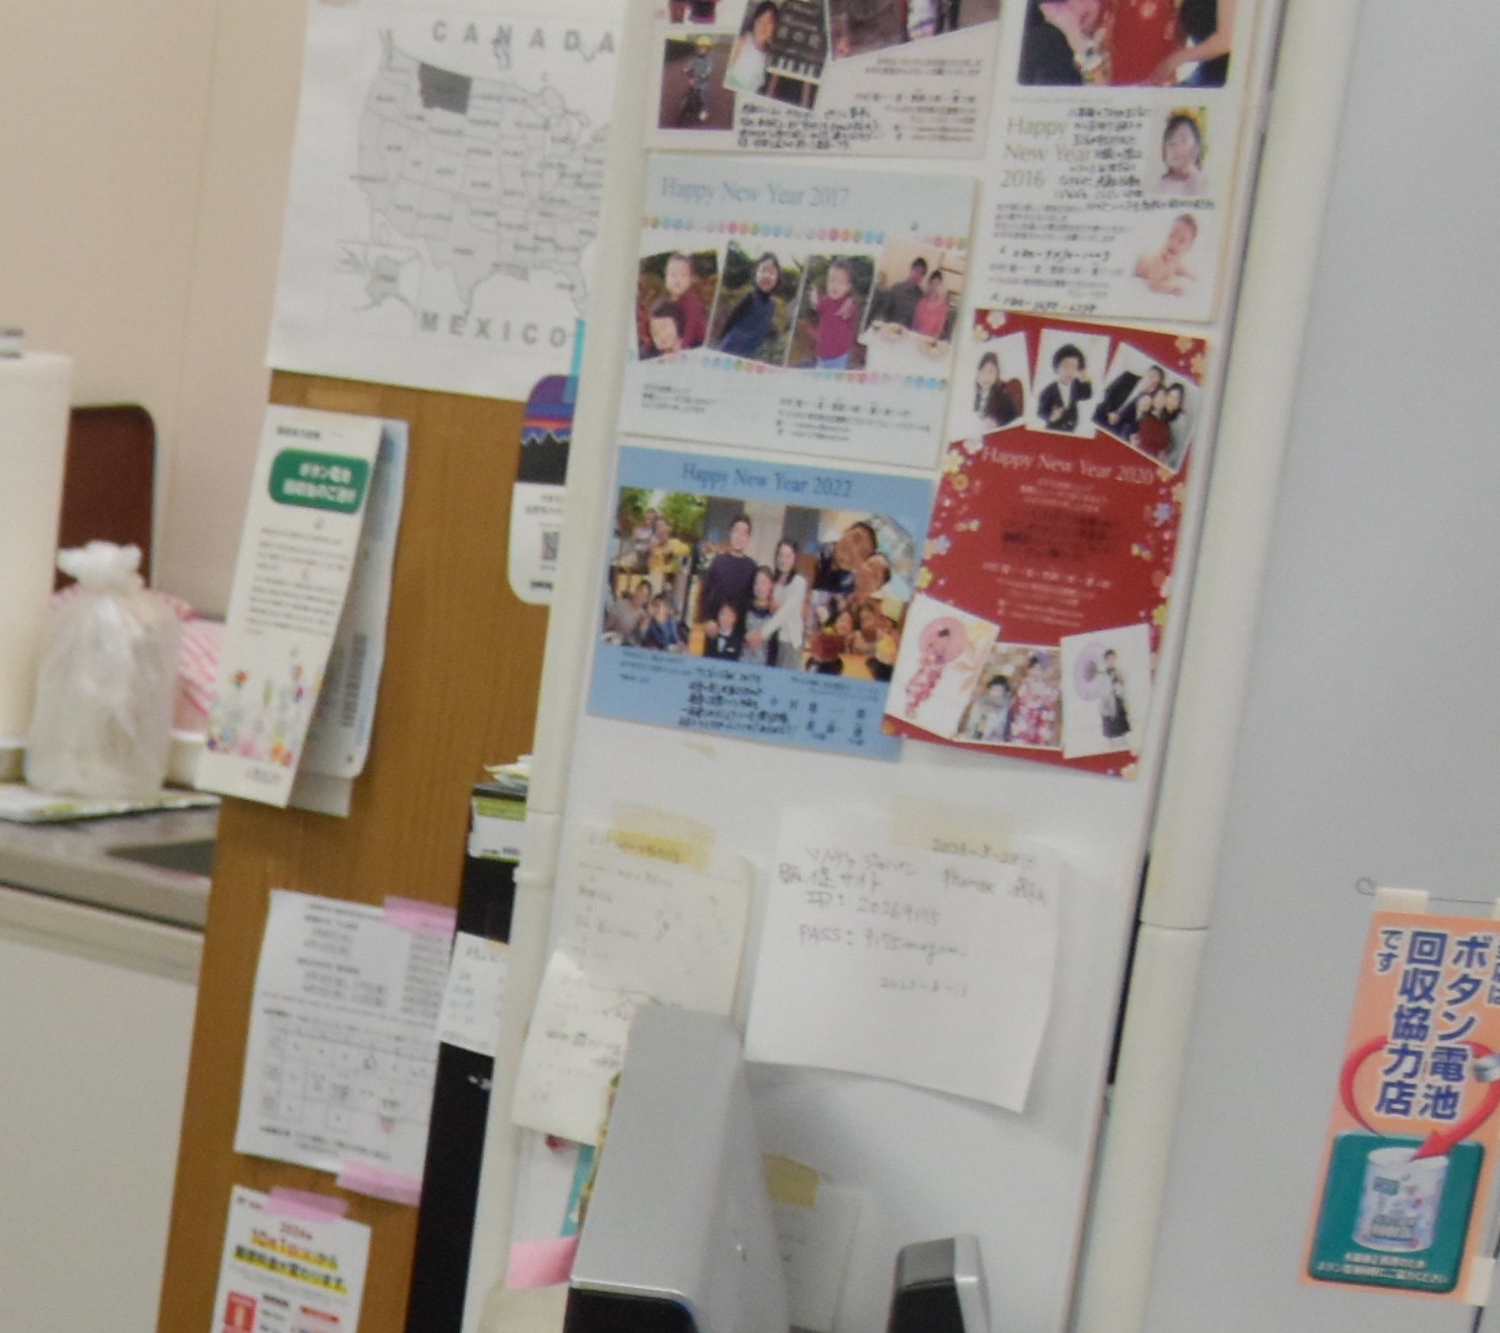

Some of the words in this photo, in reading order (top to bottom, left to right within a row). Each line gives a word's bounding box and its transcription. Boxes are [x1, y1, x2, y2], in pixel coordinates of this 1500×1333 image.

[662, 178, 716, 203] Happy
[722, 180, 760, 202] New
[766, 182, 804, 204] Year
[808, 188, 849, 208] 2017
[421, 311, 566, 348] MEXICO
[683, 462, 729, 493] Happy
[733, 466, 767, 490] New
[771, 470, 807, 494] Year
[812, 475, 852, 498] 2022
[982, 444, 1035, 473] Happy
[1039, 451, 1074, 475] New
[1078, 456, 1113, 480] Year
[1116, 460, 1155, 486] 2020
[1375, 929, 1403, 973] です
[1373, 929, 1449, 1119] 回収協力店
[1417, 934, 1493, 1123] ボタン電池
